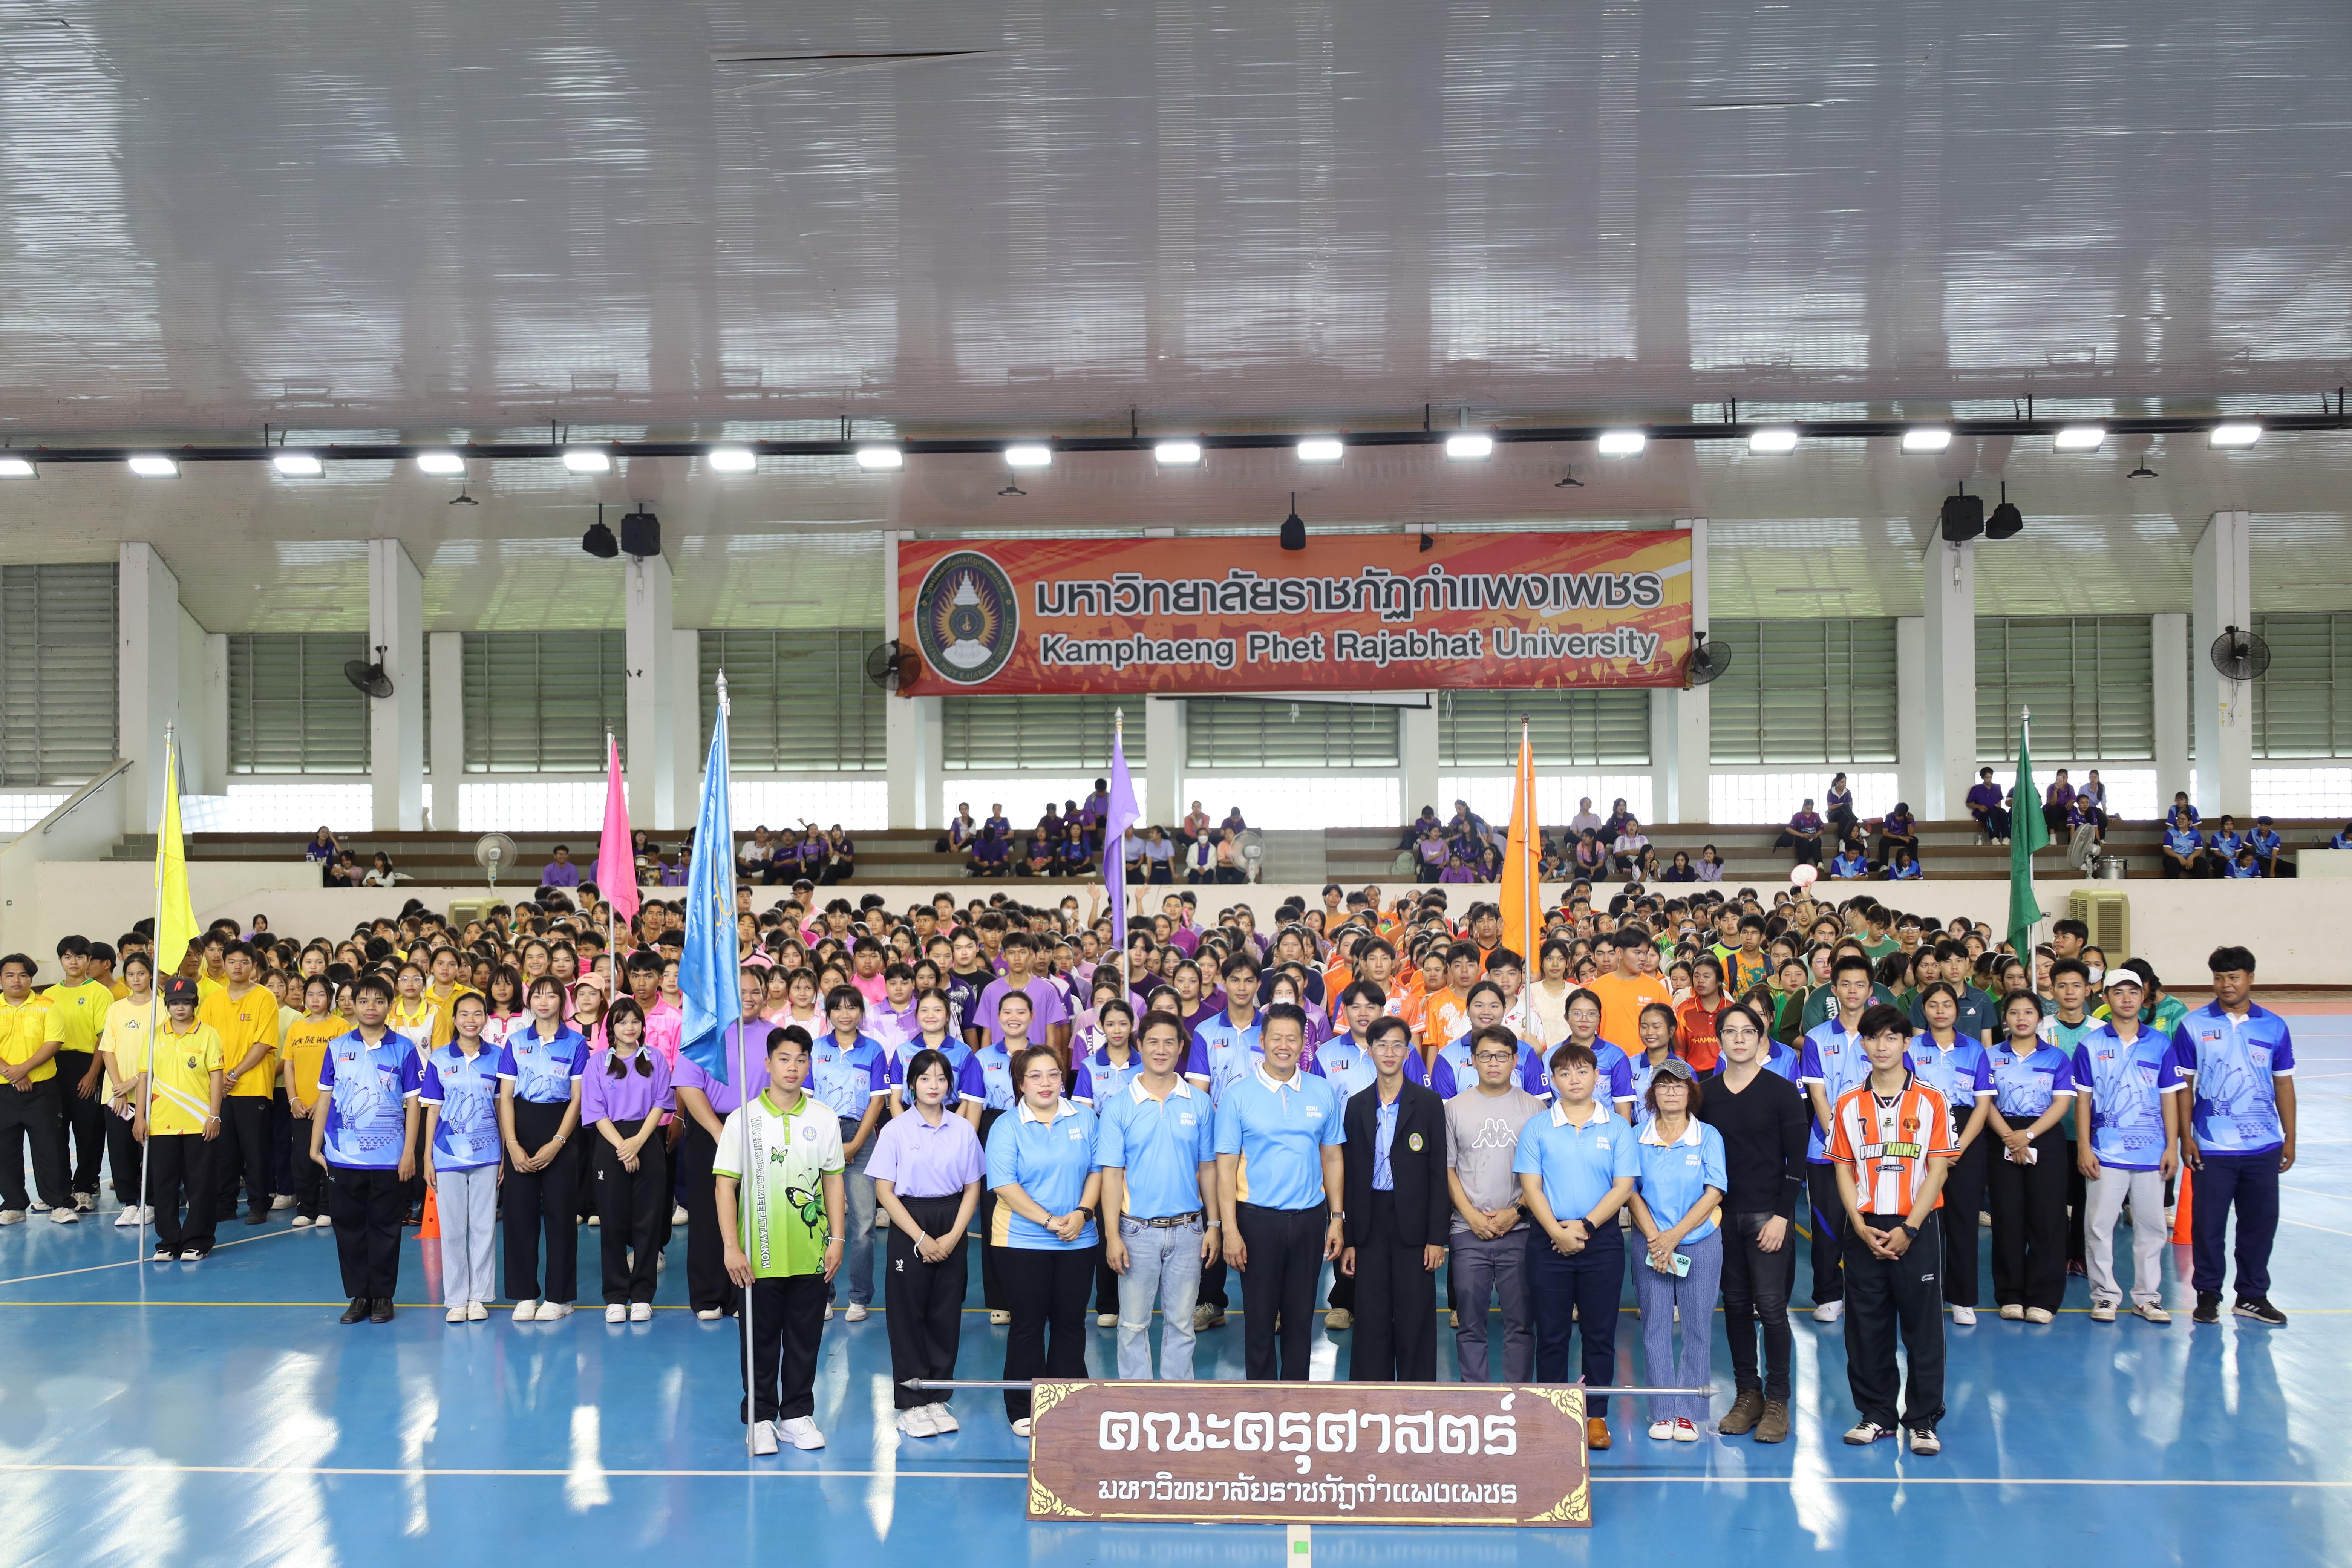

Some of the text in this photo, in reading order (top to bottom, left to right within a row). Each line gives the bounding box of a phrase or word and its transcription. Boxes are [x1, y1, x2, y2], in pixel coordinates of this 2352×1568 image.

[1038, 567, 1660, 619] มหาวิทยาลัยราชภัฏกำแพงเพชร
[1043, 629, 1657, 668] Kamphaeng Phet Rajabhat University
[174, 981, 184, 991] N
[305, 1036, 315, 1044] THE
[1331, 1059, 1348, 1070] EDU
[884, 1073, 890, 1084] 6
[1423, 1074, 1432, 1087] 6
[1541, 1073, 1549, 1086] 6
[1796, 1078, 1803, 1089] 6
[1858, 1118, 1867, 1135] 7
[1860, 1141, 1923, 1160] PHOTHONG
[751, 1116, 771, 1269] WACHIRABARAMEEPITTAYAKOM
[1099, 1393, 1517, 1474] คณะครุศาสตร์
[1098, 1471, 1517, 1510] มหาวิทยาลัยราชภัฏกำแพงเพชร
